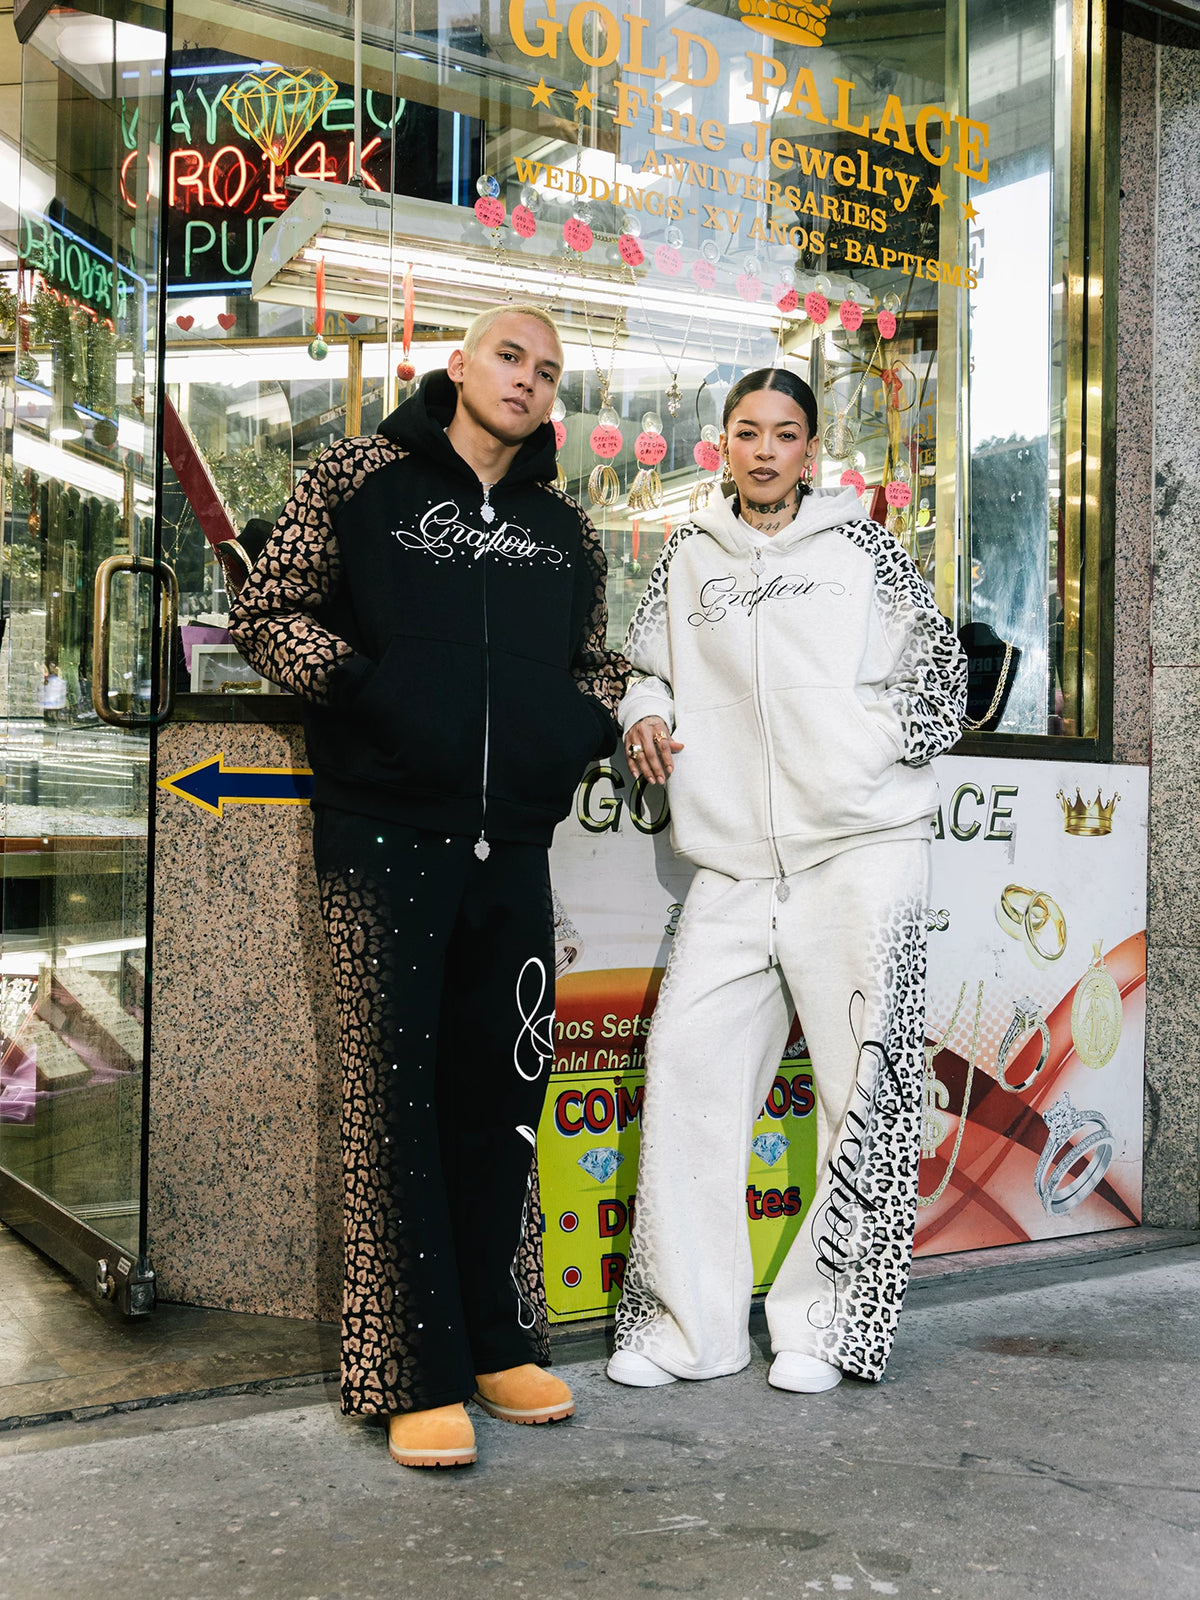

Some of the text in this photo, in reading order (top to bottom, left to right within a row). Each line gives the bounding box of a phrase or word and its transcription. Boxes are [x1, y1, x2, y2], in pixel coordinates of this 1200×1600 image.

[508, 0, 989, 184] GOLD PALACE
[613, 80, 920, 212] Fine Jewelry
[513, 156, 684, 220] WEDDINGS
[702, 204, 744, 234] XV
[748, 215, 825, 255] AÑOS
[845, 238, 979, 289] BAPTISMS
[640, 149, 888, 233] ANNIVERSARIES
